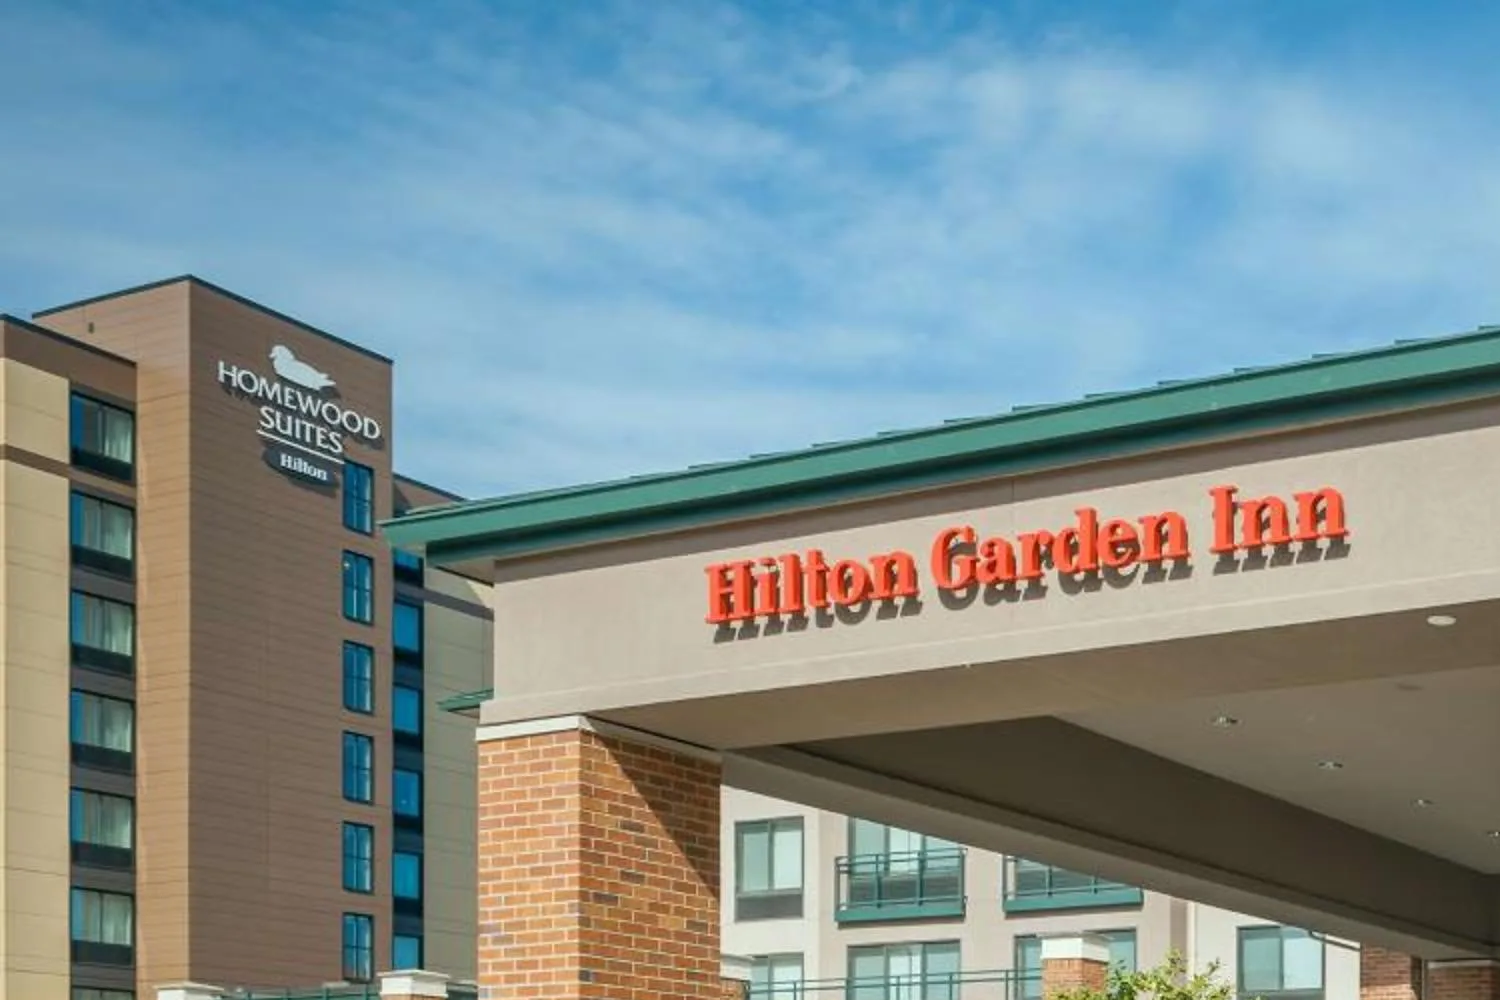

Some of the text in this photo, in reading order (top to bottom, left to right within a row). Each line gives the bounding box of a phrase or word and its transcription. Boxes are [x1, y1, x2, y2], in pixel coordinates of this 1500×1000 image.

[217, 360, 381, 439] HOMEWOOD
[260, 406, 343, 453] SUITES
[280, 453, 328, 481] Hilton
[705, 485, 1350, 625] Hilton Garden Inn
